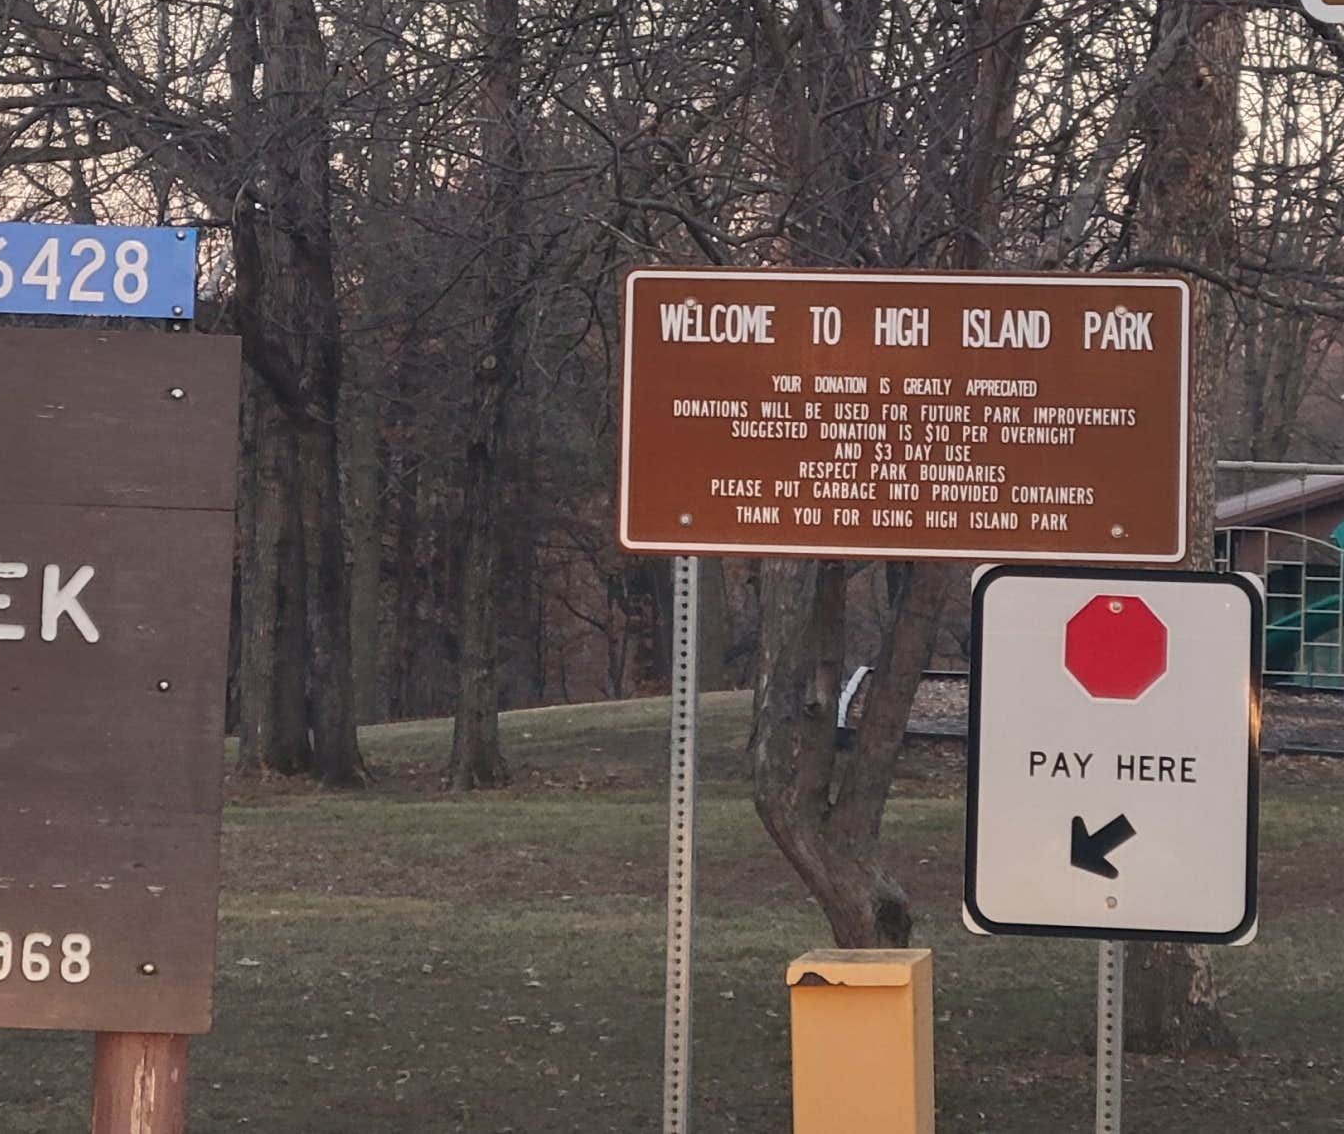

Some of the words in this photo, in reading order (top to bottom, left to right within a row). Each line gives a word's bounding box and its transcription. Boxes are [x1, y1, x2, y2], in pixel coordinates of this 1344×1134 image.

[660, 302, 775, 345] WELCOME
[809, 305, 841, 346] TO
[874, 307, 929, 348] HIGH
[962, 309, 1050, 350] ISLAND
[1083, 310, 1154, 352] PARK
[771, 375, 802, 393] YOUR
[814, 375, 867, 394] DONATION
[879, 377, 891, 395] IS
[903, 377, 952, 396] GREATLY
[965, 378, 1038, 397] APPRECIATED
[673, 399, 748, 418] DONATIONS
[761, 401, 793, 419] WILL
[805, 401, 822, 420] BE
[834, 402, 870, 421] USED
[882, 403, 908, 422] FOR
[920, 404, 971, 423] FUTURE
[983, 405, 1020, 424] PARK
[1033, 406, 1136, 426] IMPROVEMENTS
[731, 420, 808, 439] SUGGESTED
[820, 422, 887, 441] DONATION
[899, 424, 913, 442] IS
[924, 422, 950, 444] $10
[962, 425, 988, 443] PER
[1001, 425, 1076, 445] OVERNIGHT
[834, 442, 862, 460] AND
[874, 441, 892, 462] $3
[904, 443, 932, 461] DAY
[945, 444, 971, 462] USE
[799, 461, 858, 480] RESPECT
[870, 462, 907, 481] PARK
[919, 464, 1006, 483] BOUNDARIES
[711, 478, 763, 497] PLEASE
[774, 480, 801, 498] PUT
[812, 481, 877, 500] GARBAGE
[889, 483, 920, 501] INTO
[932, 484, 999, 503] PROVIDED
[1011, 485, 1094, 505] CONTAINERS
[735, 505, 780, 524] THANK
[793, 507, 821, 525] YOU
[833, 508, 860, 526] FOR
[872, 509, 913, 528] USING
[925, 510, 958, 528] HIGH
[970, 511, 1018, 530] ISLAND
[1031, 513, 1068, 531] PARK
[1029, 750, 1094, 779] PAY
[1117, 754, 1197, 783] HERE
